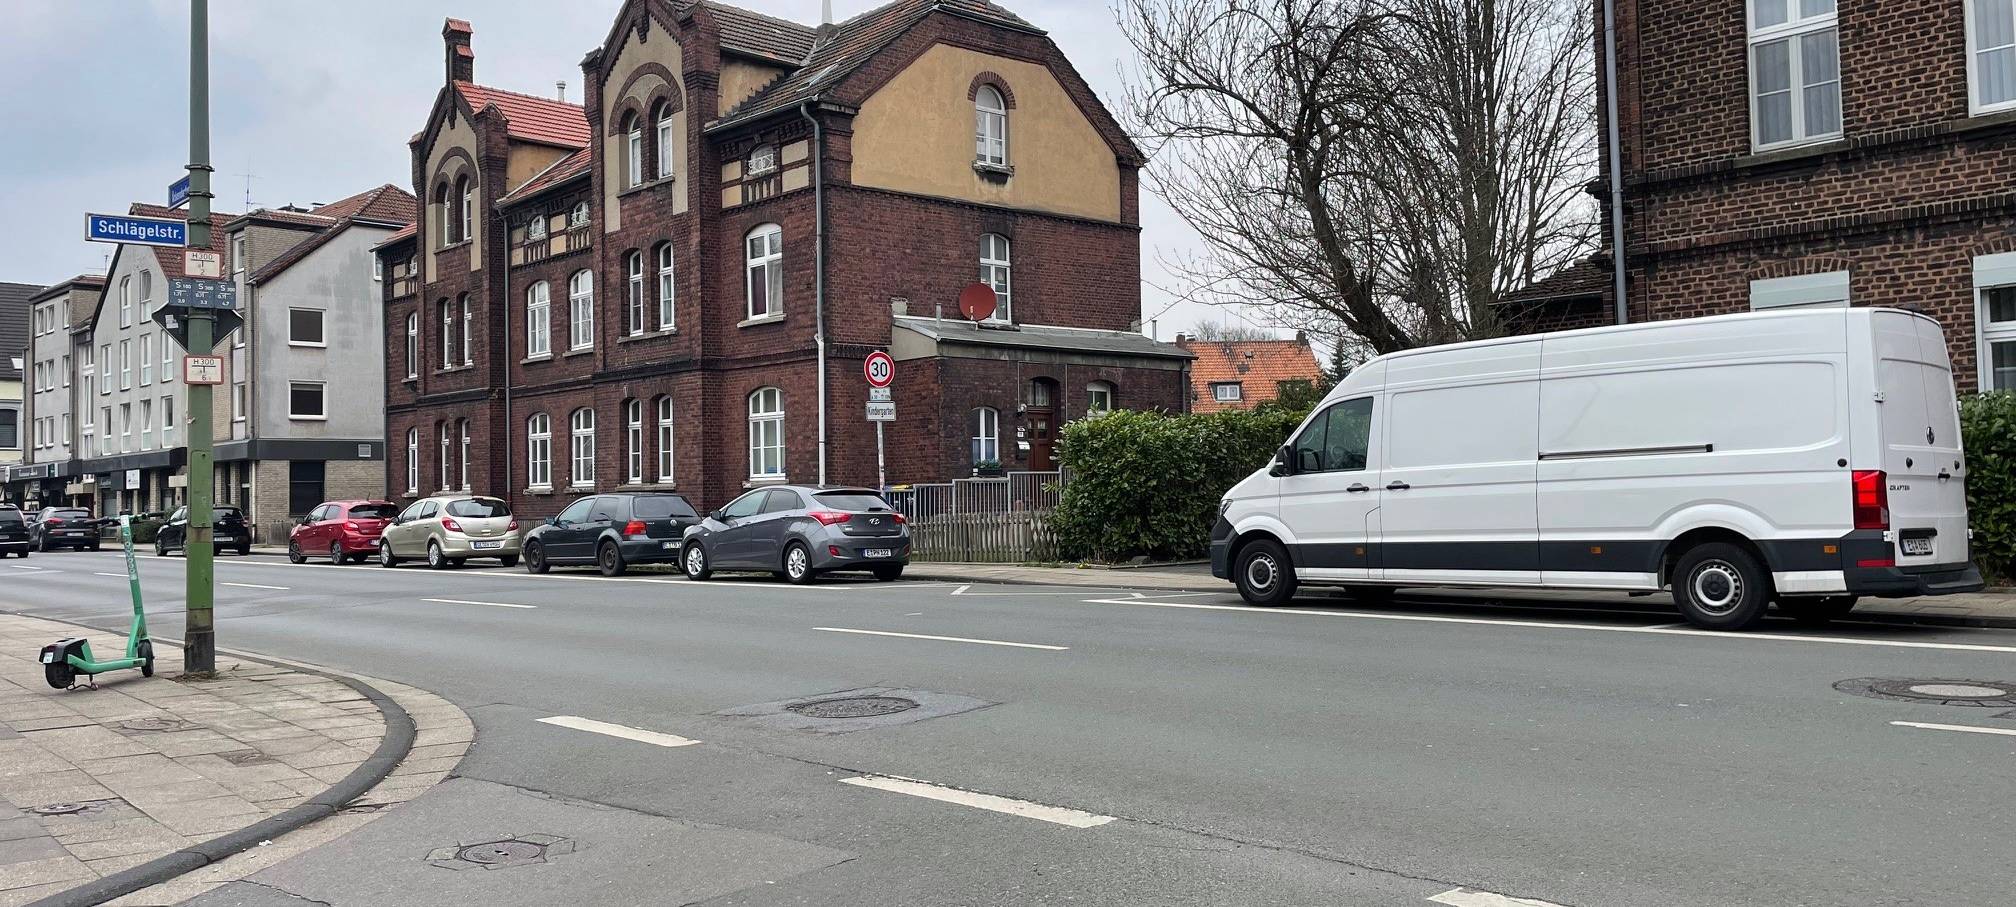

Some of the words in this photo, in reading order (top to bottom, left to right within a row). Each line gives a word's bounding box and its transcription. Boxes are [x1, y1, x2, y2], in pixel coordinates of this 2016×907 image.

[98, 220, 182, 239] Schlägelstr.
[871, 362, 888, 377] 30
[867, 406, 894, 417] Kindergarten
